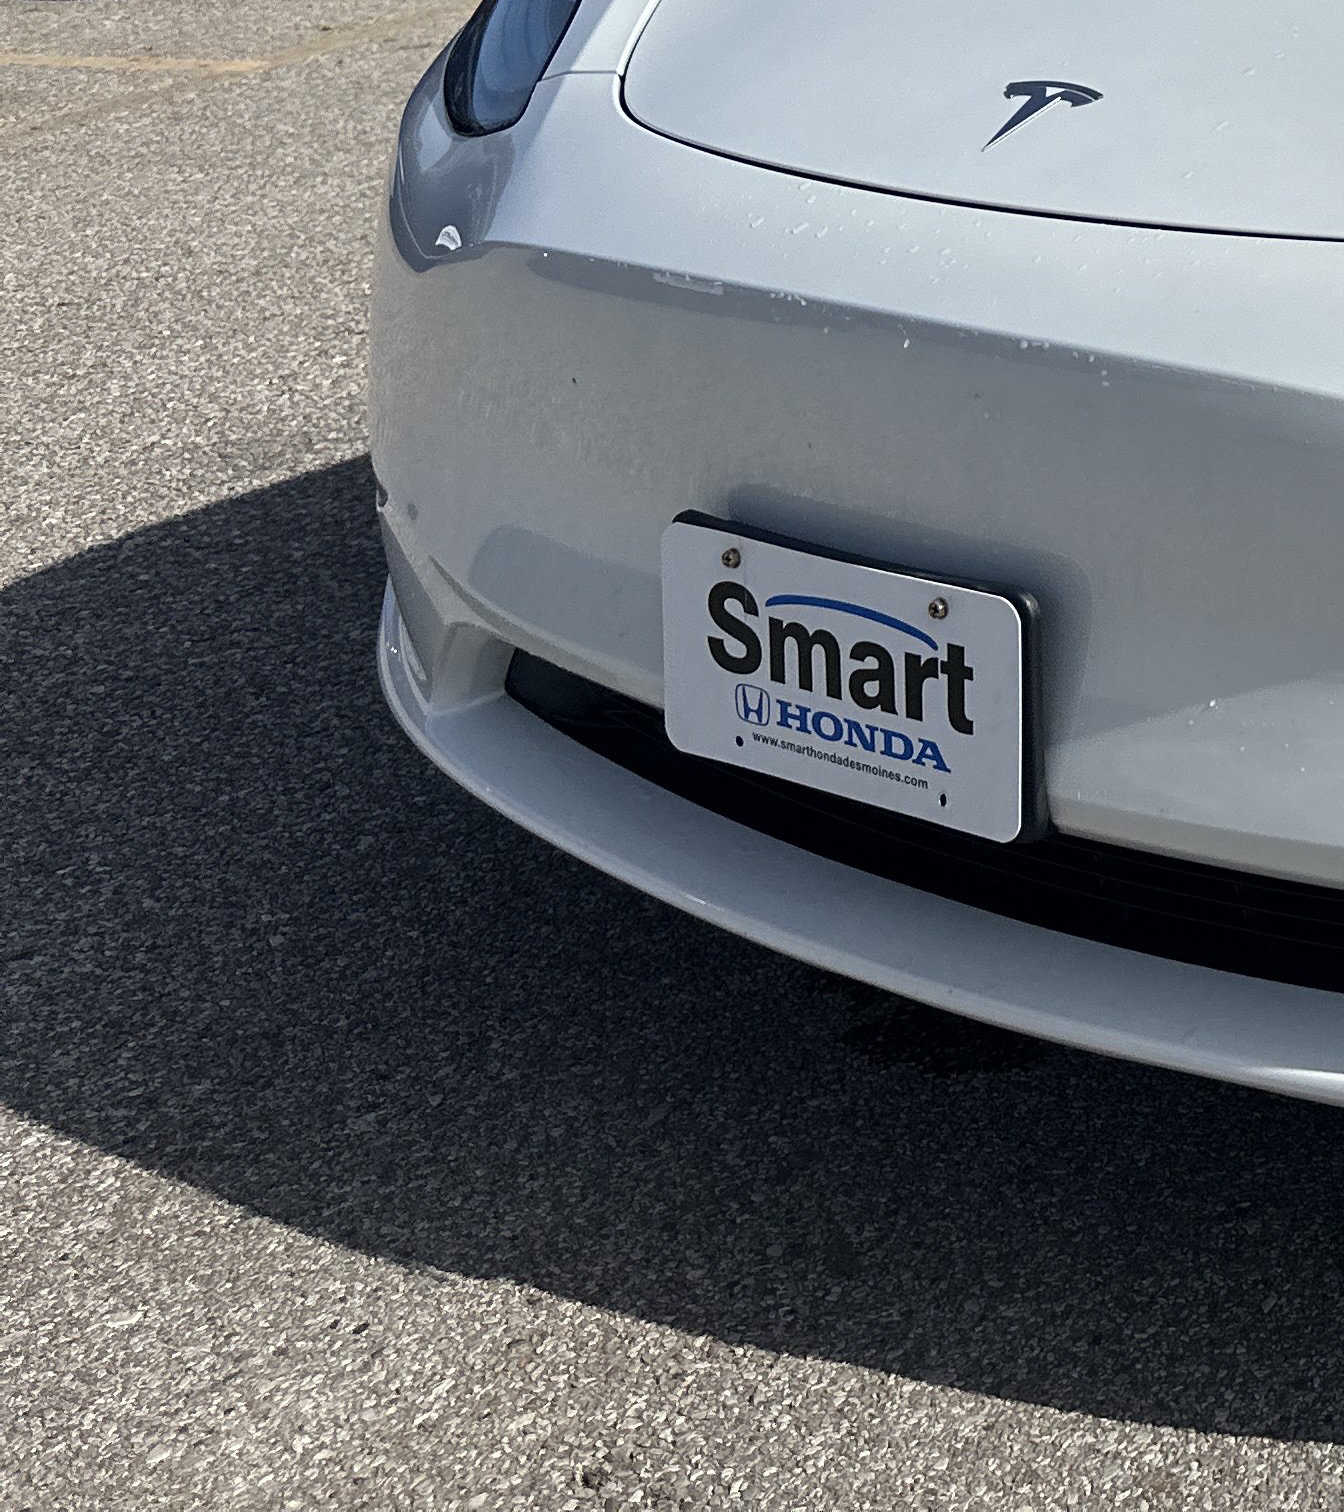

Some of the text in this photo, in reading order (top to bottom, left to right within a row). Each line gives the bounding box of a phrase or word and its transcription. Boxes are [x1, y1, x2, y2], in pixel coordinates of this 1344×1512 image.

[706, 580, 975, 737] Smart
[751, 730, 930, 790] www.smarthondadesmoines.com
[776, 696, 951, 775] HONDA
